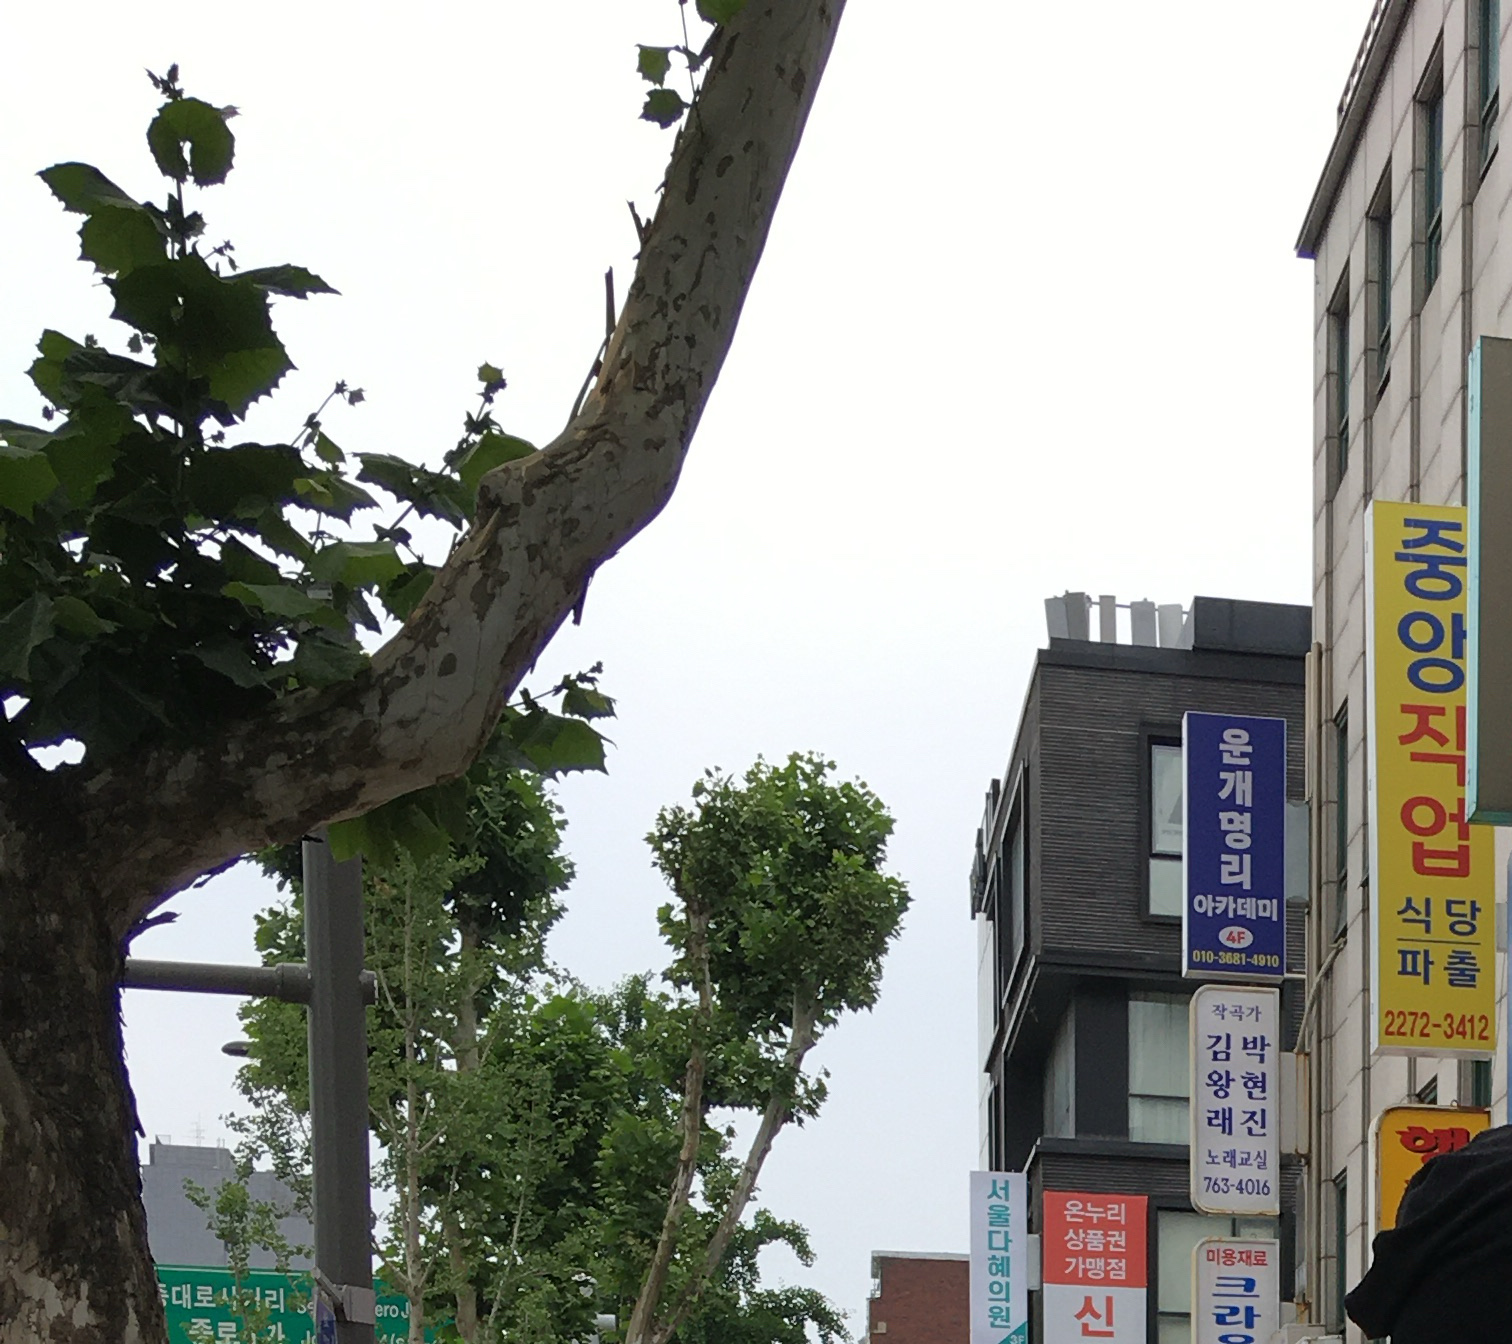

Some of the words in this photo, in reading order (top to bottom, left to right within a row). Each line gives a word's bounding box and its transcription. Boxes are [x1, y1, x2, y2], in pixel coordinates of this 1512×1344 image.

[1394, 517, 1470, 880] 중앙직업
[1193, 894, 1278, 922] 아카데미
[1397, 897, 1481, 937] 식당
[1226, 930, 1246, 944] 4F
[1192, 950, 1280, 968] 010-3681-4910
[1397, 947, 1481, 990] 파출
[1211, 1004, 1262, 1023] 작곡가
[1385, 1009, 1490, 1043] 2272-3412
[1205, 1032, 1236, 1137] 김왕래
[1239, 1034, 1272, 1138] 박현진
[1205, 1148, 1268, 1170] 노래교실
[1203, 1176, 1271, 1197] 763-4016
[1064, 1200, 1126, 1225] 온누리
[1064, 1228, 1127, 1252] 상품권
[1064, 1256, 1127, 1280] 가맹점
[1206, 1248, 1269, 1267] 미용재료
